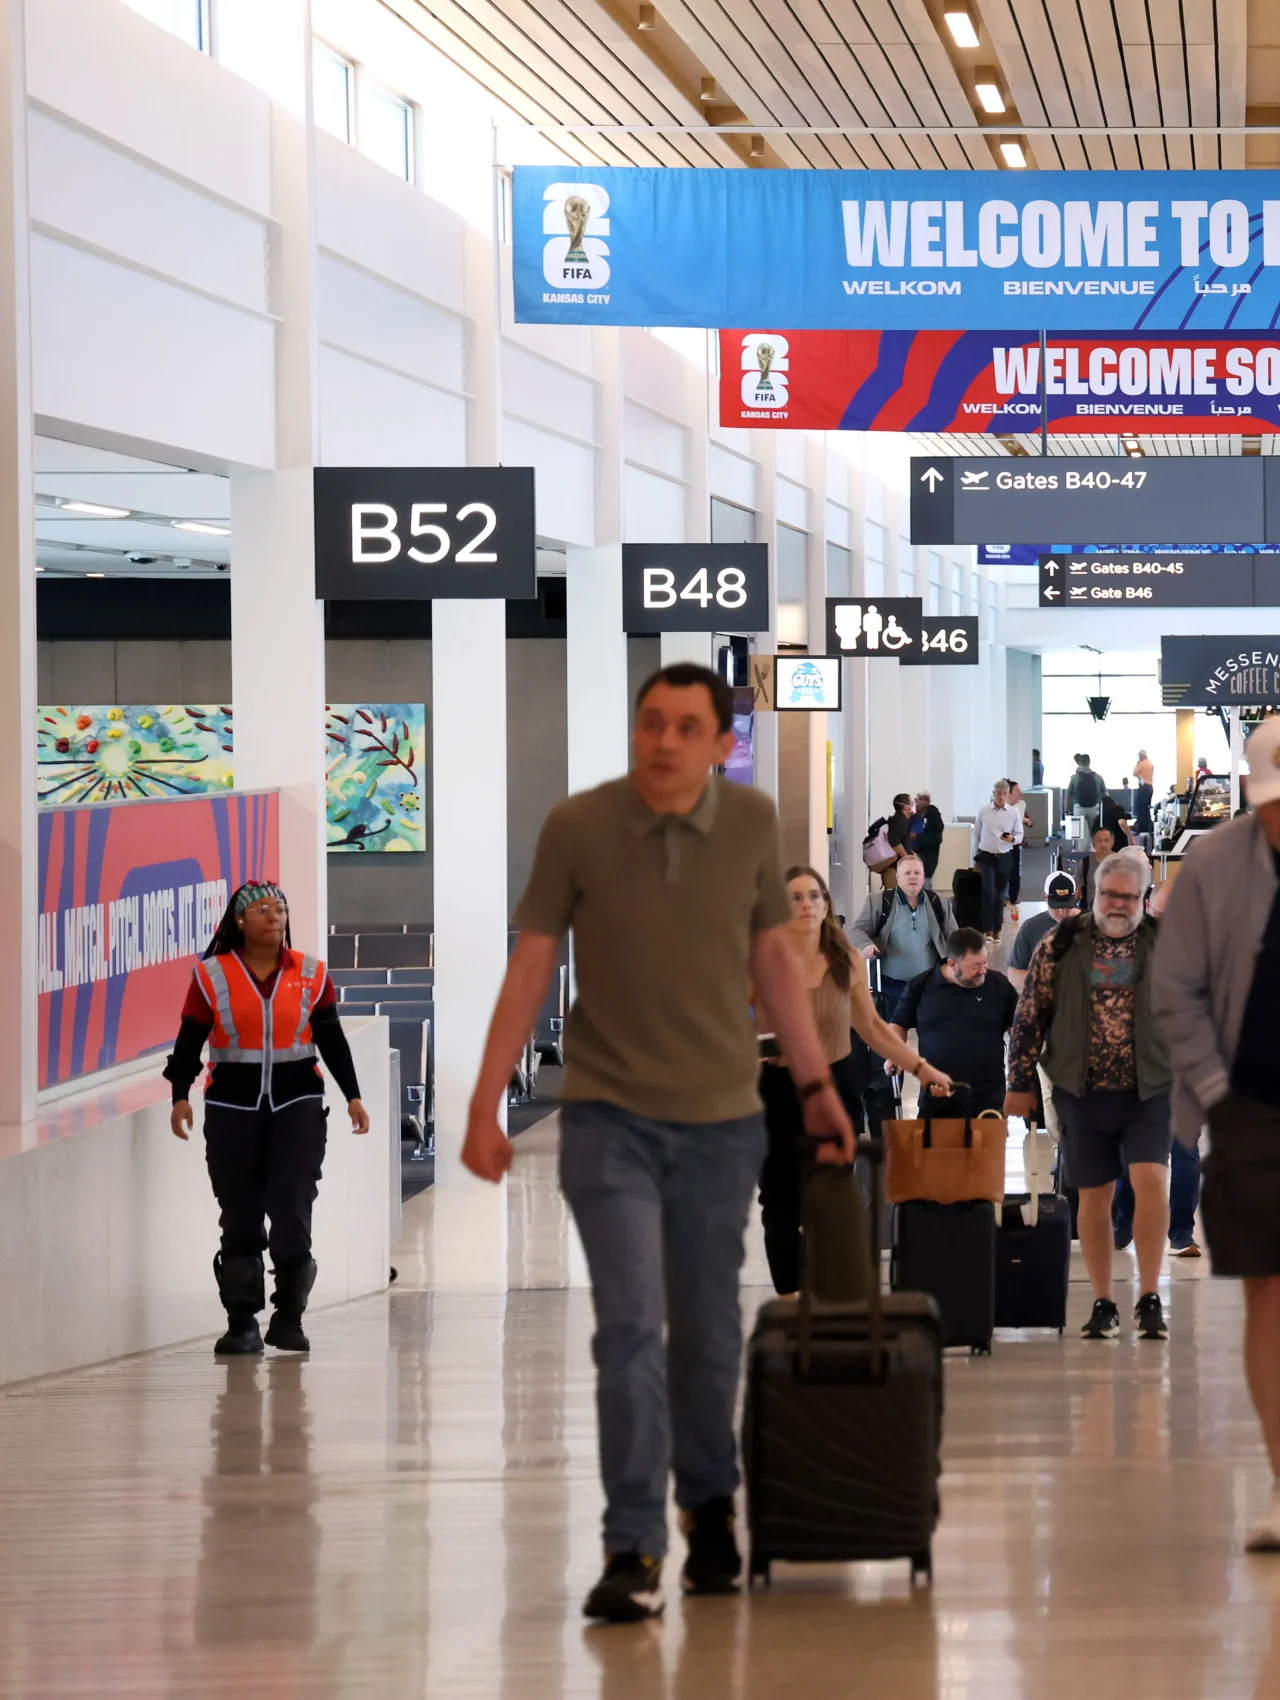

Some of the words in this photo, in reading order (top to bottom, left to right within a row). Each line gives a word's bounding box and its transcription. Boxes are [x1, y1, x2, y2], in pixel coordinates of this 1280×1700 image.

[842, 199, 1160, 268] WELCOME
[1171, 199, 1250, 268] TO
[562, 268, 592, 280] FIFA
[842, 280, 962, 296] WELKOM
[1003, 280, 1155, 296] BIENVENUE
[542, 292, 585, 304] KANSAS
[586, 293, 611, 305] CITY
[993, 347, 1217, 396] WELCOME
[755, 393, 776, 402] FIFA
[740, 410, 771, 419] KANSAS
[771, 411, 789, 419] CITY
[963, 403, 1042, 415] WELKOM
[1076, 404, 1184, 415] BIENVENUE
[996, 471, 1059, 490] Gates
[1066, 471, 1147, 489] B40-47
[351, 502, 498, 563] B52
[1090, 562, 1130, 574] Gates
[1132, 562, 1184, 574] B40-45
[643, 567, 748, 609] B48
[1090, 586, 1123, 599] Gate
[1125, 586, 1153, 599] B46
[1230, 667, 1269, 694] COFFEE
[64, 903, 108, 989] MATCH.
[109, 895, 143, 978] PITCH.
[143, 888, 177, 968] BOOTS.
[178, 884, 195, 958] KIT.
